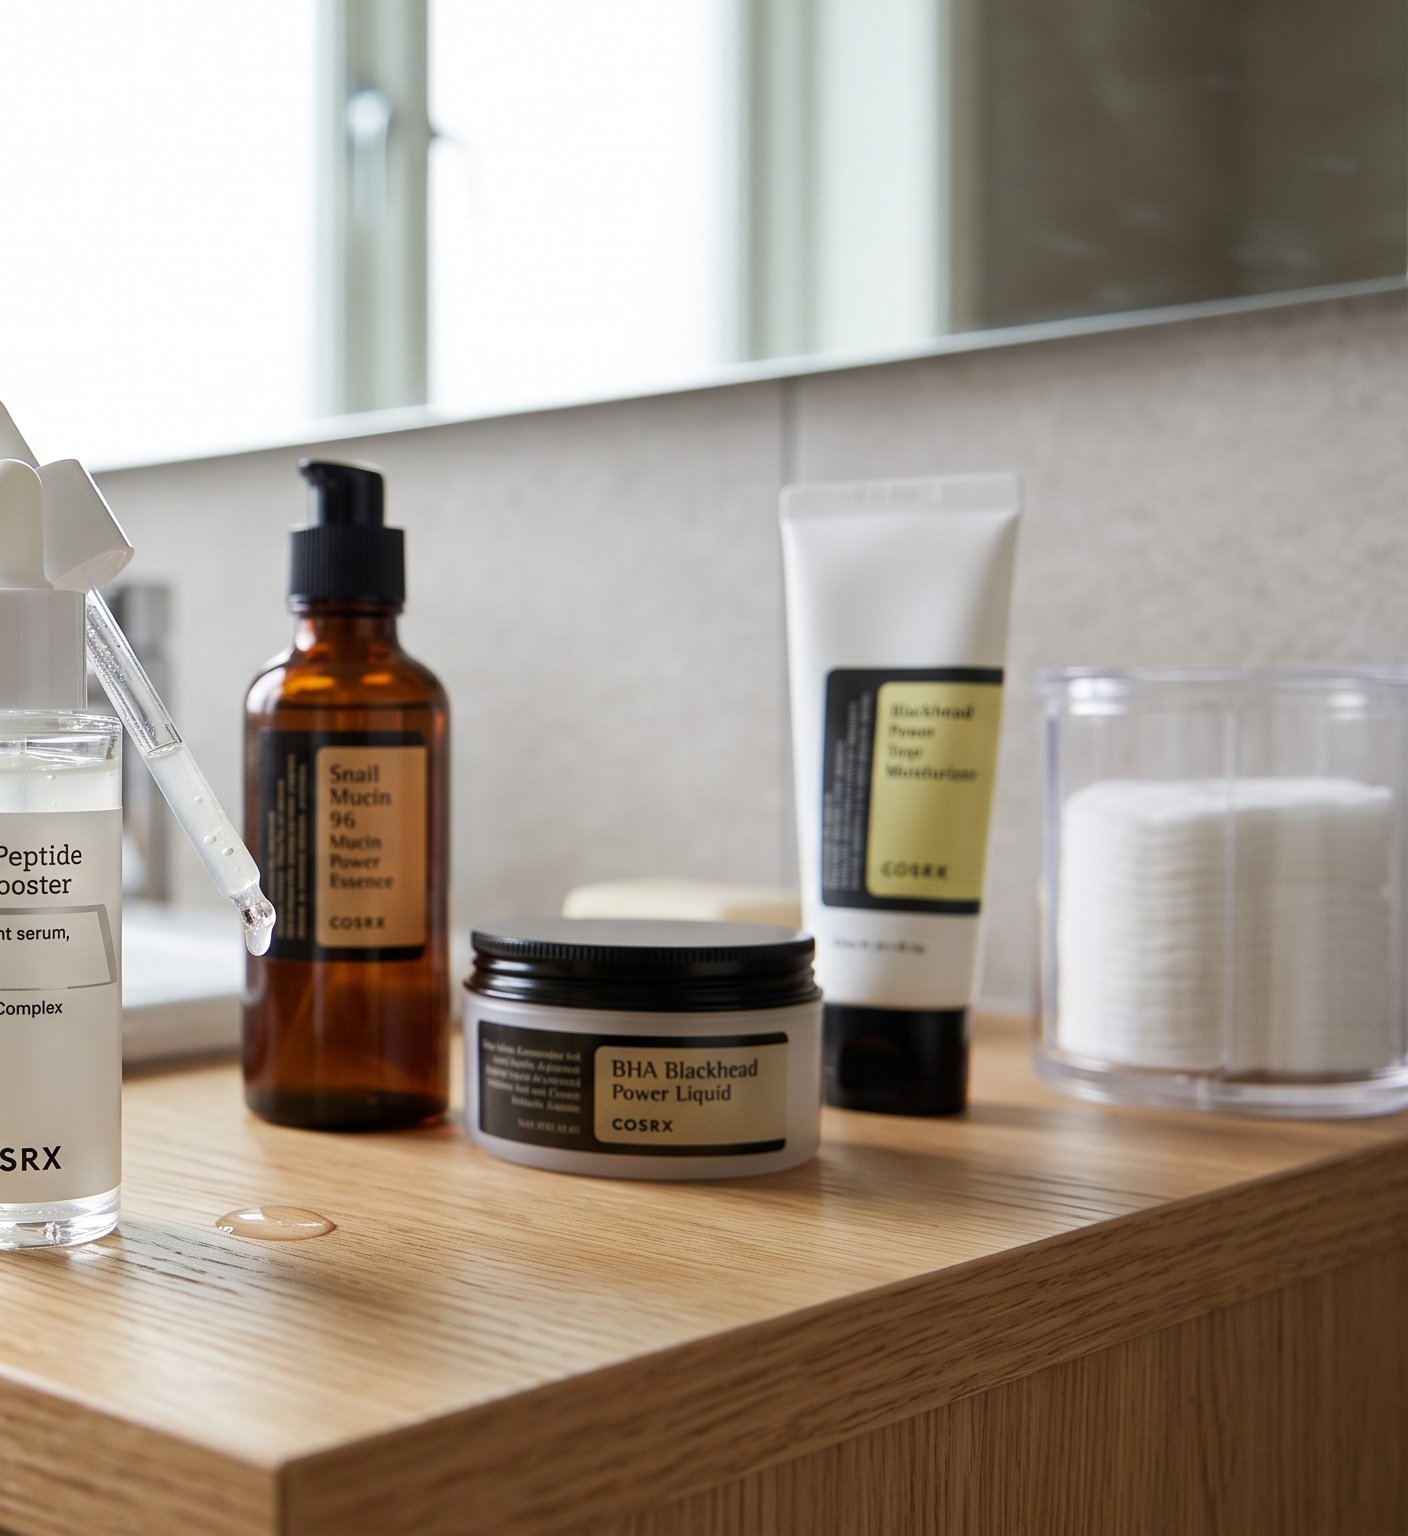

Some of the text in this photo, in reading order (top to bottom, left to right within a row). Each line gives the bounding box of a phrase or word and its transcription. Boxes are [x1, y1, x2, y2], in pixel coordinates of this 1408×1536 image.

[329, 763, 379, 783] Snail
[329, 788, 391, 806] Mucin
[329, 811, 356, 829] 96
[329, 834, 382, 849] Mucin
[329, 854, 380, 869] Power
[329, 874, 393, 890] Essence
[329, 915, 385, 930] COSRX
[17, 926, 70, 942] serum,
[612, 1058, 758, 1079] BHA Blackhead
[612, 1084, 731, 1106] Power Liquid
[612, 1118, 673, 1132] COSRX
